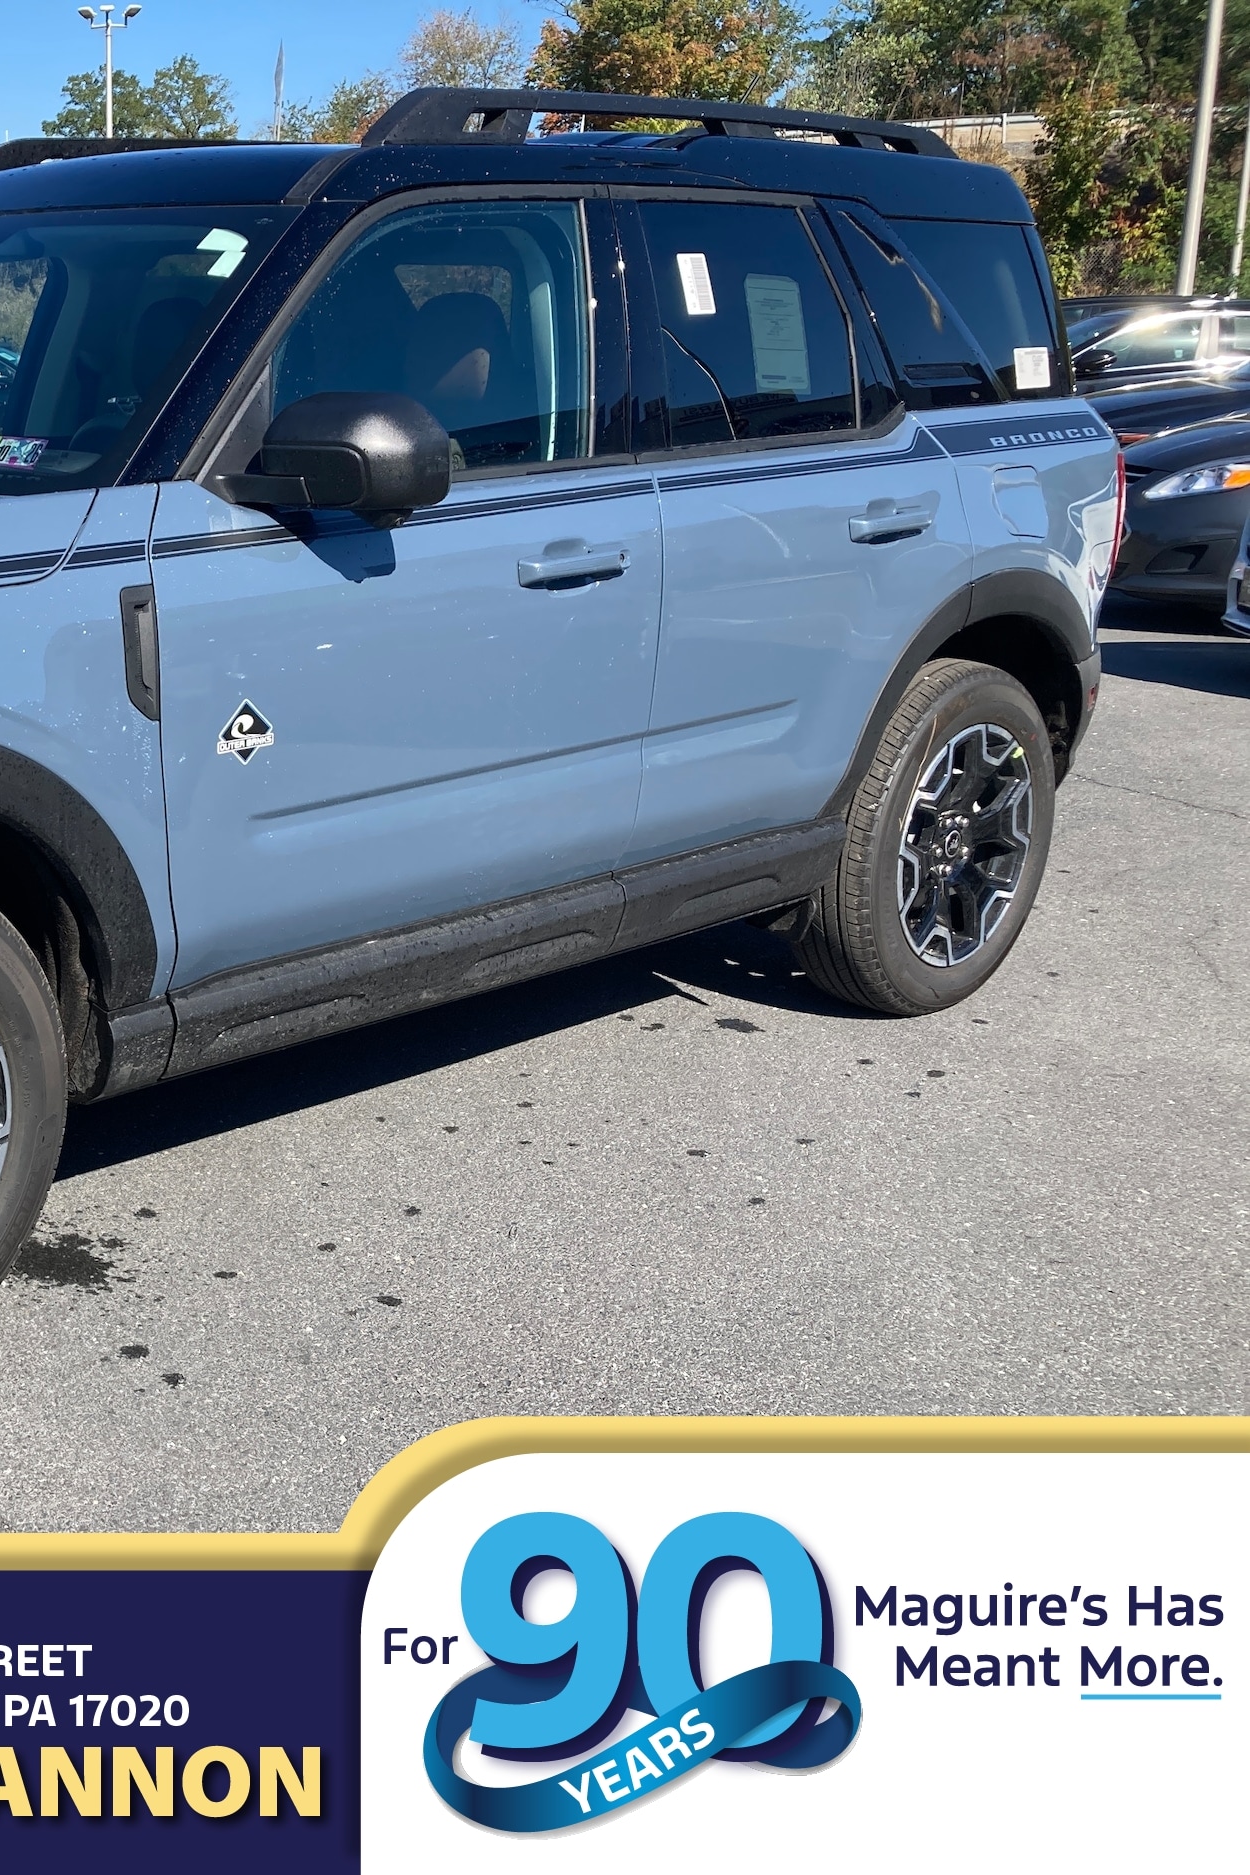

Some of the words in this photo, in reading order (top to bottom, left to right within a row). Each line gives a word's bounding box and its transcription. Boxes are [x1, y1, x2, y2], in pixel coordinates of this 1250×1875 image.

[989, 427, 1099, 447] BRONCO
[23, 443, 43, 463] 26
[219, 739, 246, 752] OUTER
[246, 735, 272, 747] BANKS
